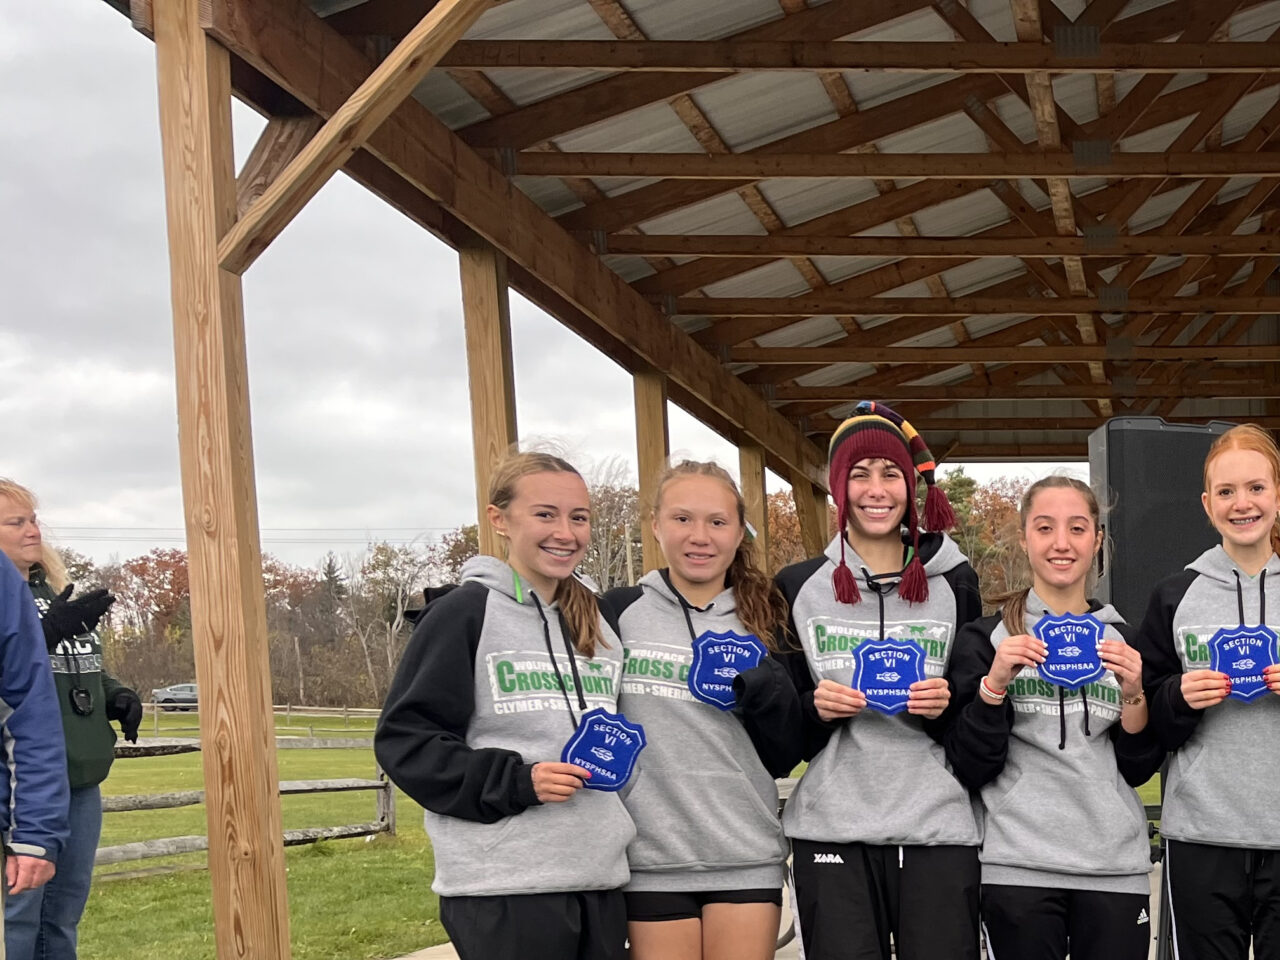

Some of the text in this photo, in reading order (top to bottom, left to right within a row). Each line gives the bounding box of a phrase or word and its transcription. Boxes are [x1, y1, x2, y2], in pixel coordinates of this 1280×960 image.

[827, 625, 879, 637] WOLFPACK
[1048, 625, 1090, 636] SECTION
[815, 624, 866, 653] CROS
[1064, 633, 1076, 642] VI
[1223, 638, 1263, 651] SECTION
[1238, 646, 1249, 655] VI
[630, 649, 685, 663] WOLFPACK
[707, 645, 750, 657] SECTION
[868, 651, 910, 661] SECTION
[723, 653, 735, 663] VI
[883, 659, 895, 668] VI
[702, 683, 733, 692] NYSPH
[494, 699, 543, 714] CLYMER
[594, 724, 632, 745] SECTION
[604, 734, 616, 746] VI
[574, 757, 617, 780] NYSPHSAA
[814, 853, 844, 863] XARA
